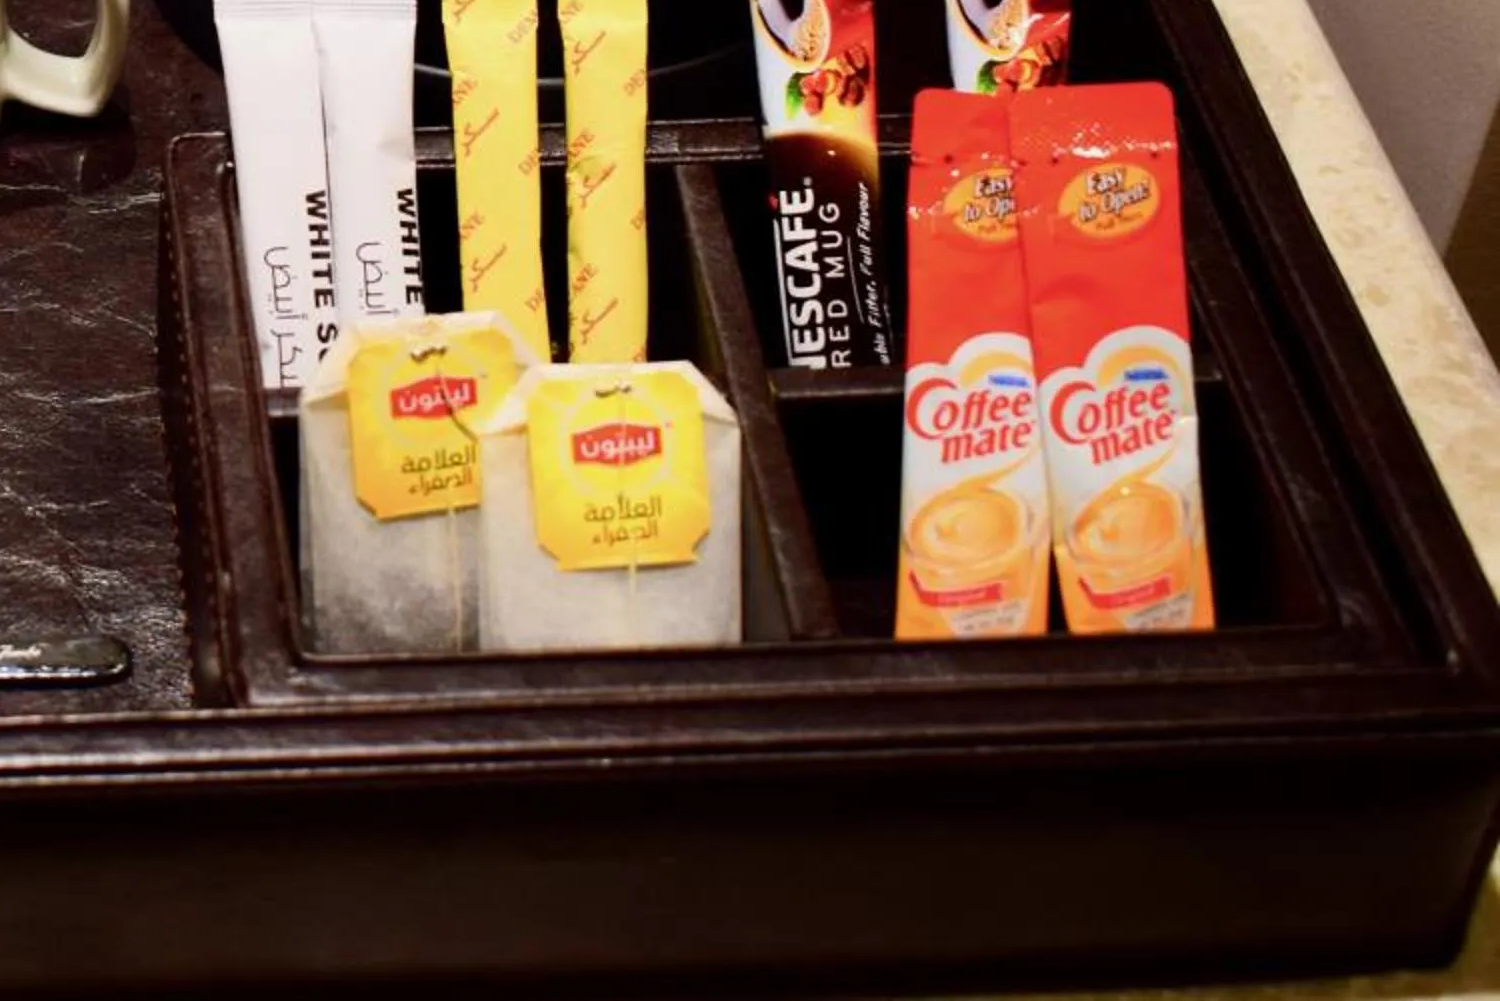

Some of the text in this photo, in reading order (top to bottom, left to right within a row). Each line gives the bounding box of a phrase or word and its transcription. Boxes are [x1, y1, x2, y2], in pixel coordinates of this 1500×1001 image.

[1086, 167, 1124, 196] Easy
[855, 181, 871, 242] Flavour
[305, 190, 335, 309] WHITE
[397, 188, 424, 305] WHITE
[859, 246, 874, 276] Full
[818, 202, 852, 369] RED MUG
[906, 377, 1032, 440] Coffee
[1050, 381, 1171, 445] Coffee
[400, 444, 477, 474] العلامة
[941, 421, 1034, 464] mate
[1088, 412, 1174, 466] mate
[583, 493, 662, 523] العلامة
